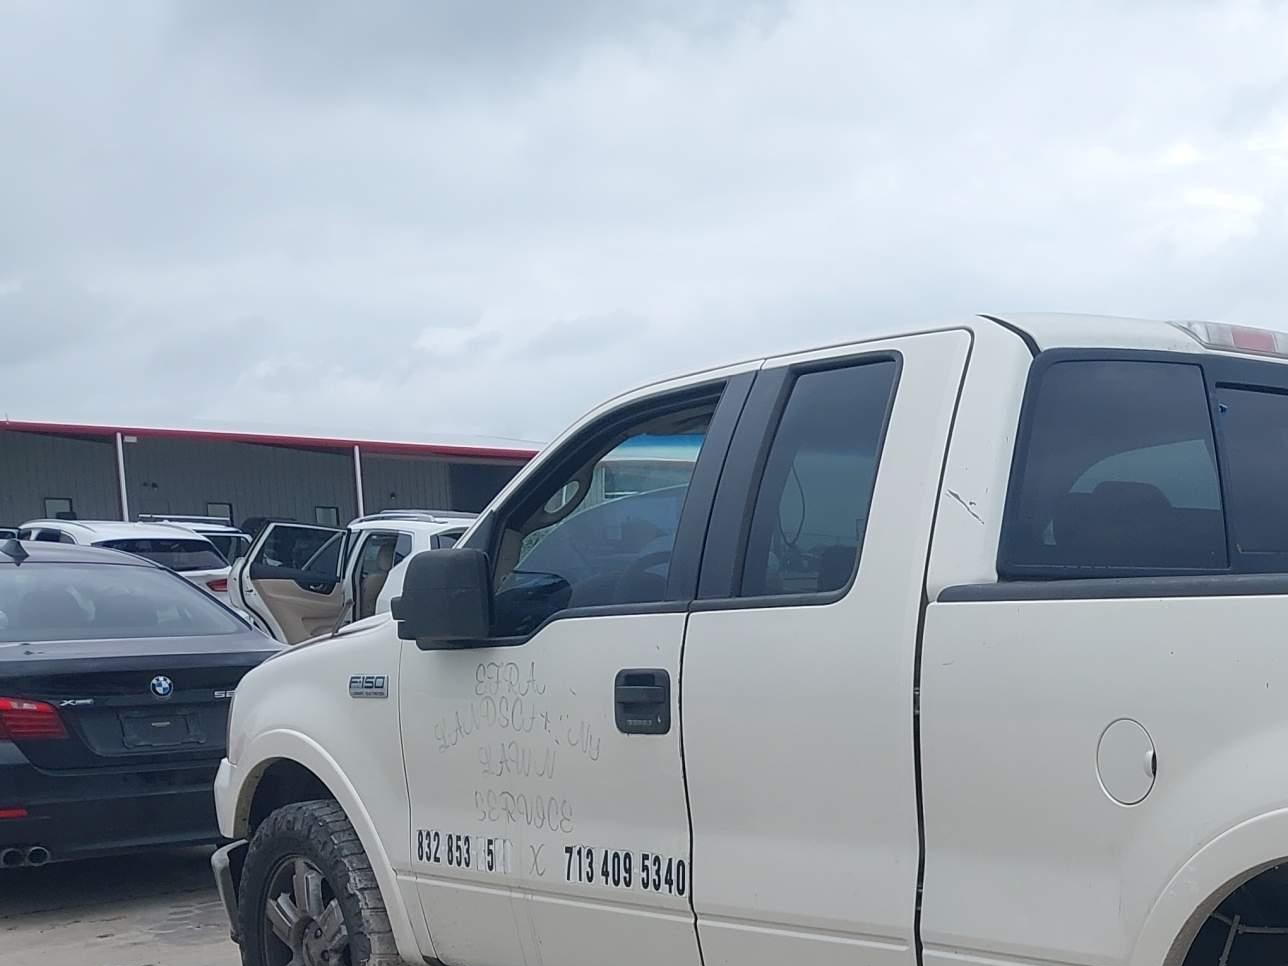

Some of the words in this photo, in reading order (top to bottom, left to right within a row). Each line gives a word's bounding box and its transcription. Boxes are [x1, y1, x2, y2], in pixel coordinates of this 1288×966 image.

[417, 830, 441, 863] 832
[447, 833, 471, 868] 853
[565, 846, 594, 883] 713
[601, 850, 632, 887] 409
[641, 853, 686, 896] 5340
